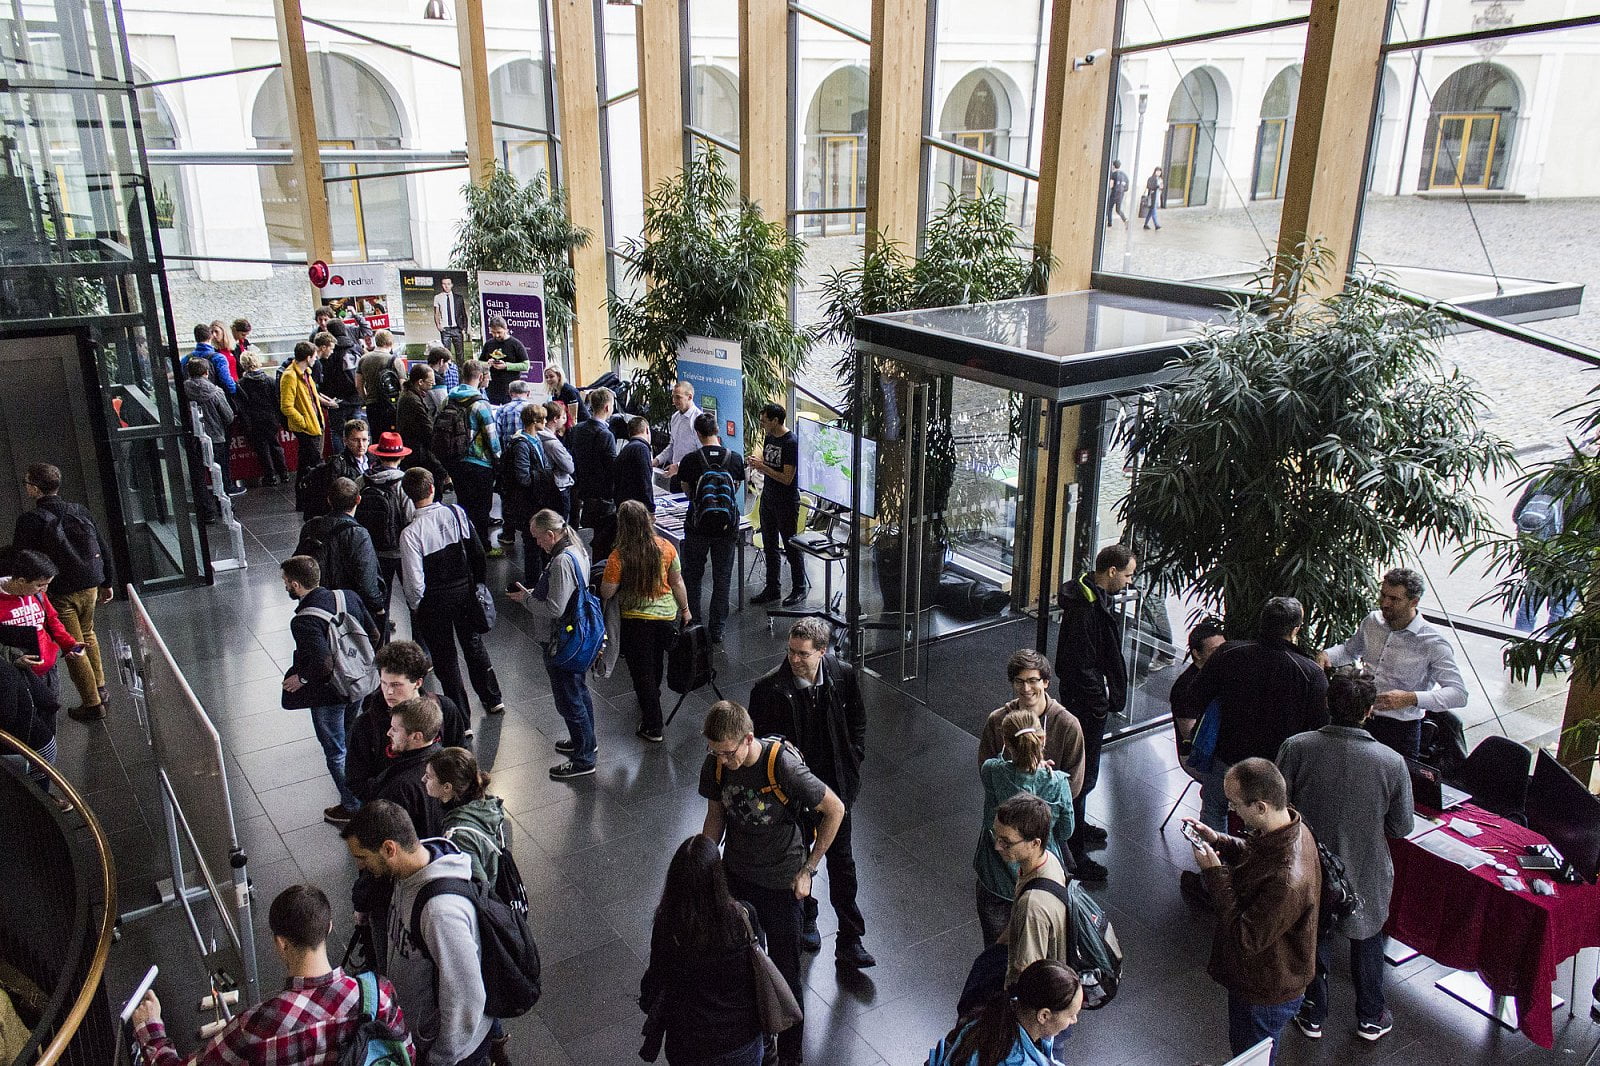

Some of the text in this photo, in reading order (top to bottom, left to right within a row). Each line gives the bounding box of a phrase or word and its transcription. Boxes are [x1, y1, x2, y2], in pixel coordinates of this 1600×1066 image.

[483, 279, 512, 287] CompTIA
[486, 299, 510, 309] Gain 3
[486, 308, 539, 319] Qualifications
[371, 318, 386, 327] HAT
[507, 318, 541, 329] CompTIA
